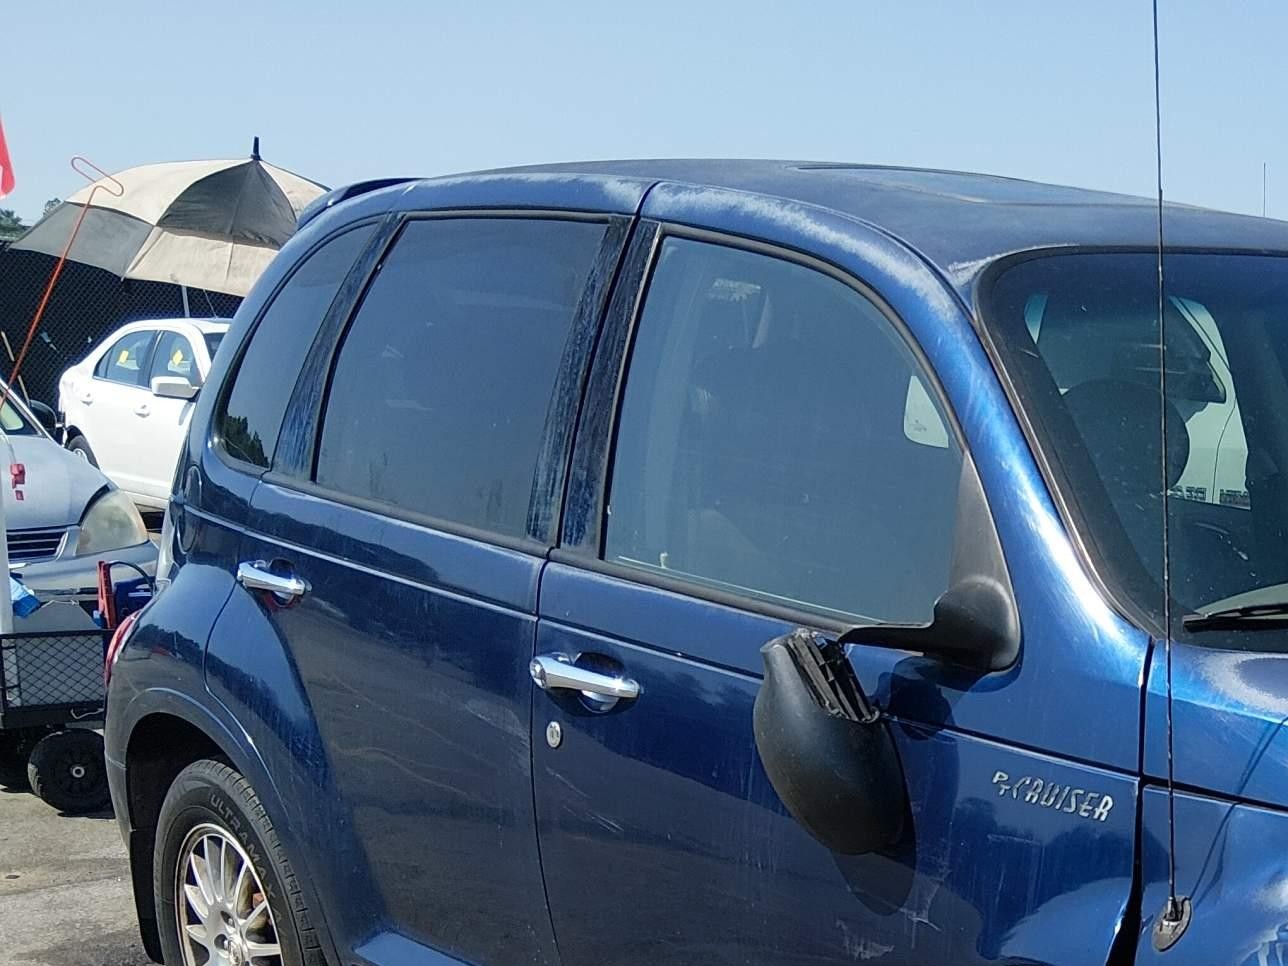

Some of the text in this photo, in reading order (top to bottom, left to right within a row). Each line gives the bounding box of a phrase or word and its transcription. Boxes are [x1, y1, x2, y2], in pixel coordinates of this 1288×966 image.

[992, 771, 1114, 822] PT CRUISER
[210, 793, 277, 900] ULTRAMAX
